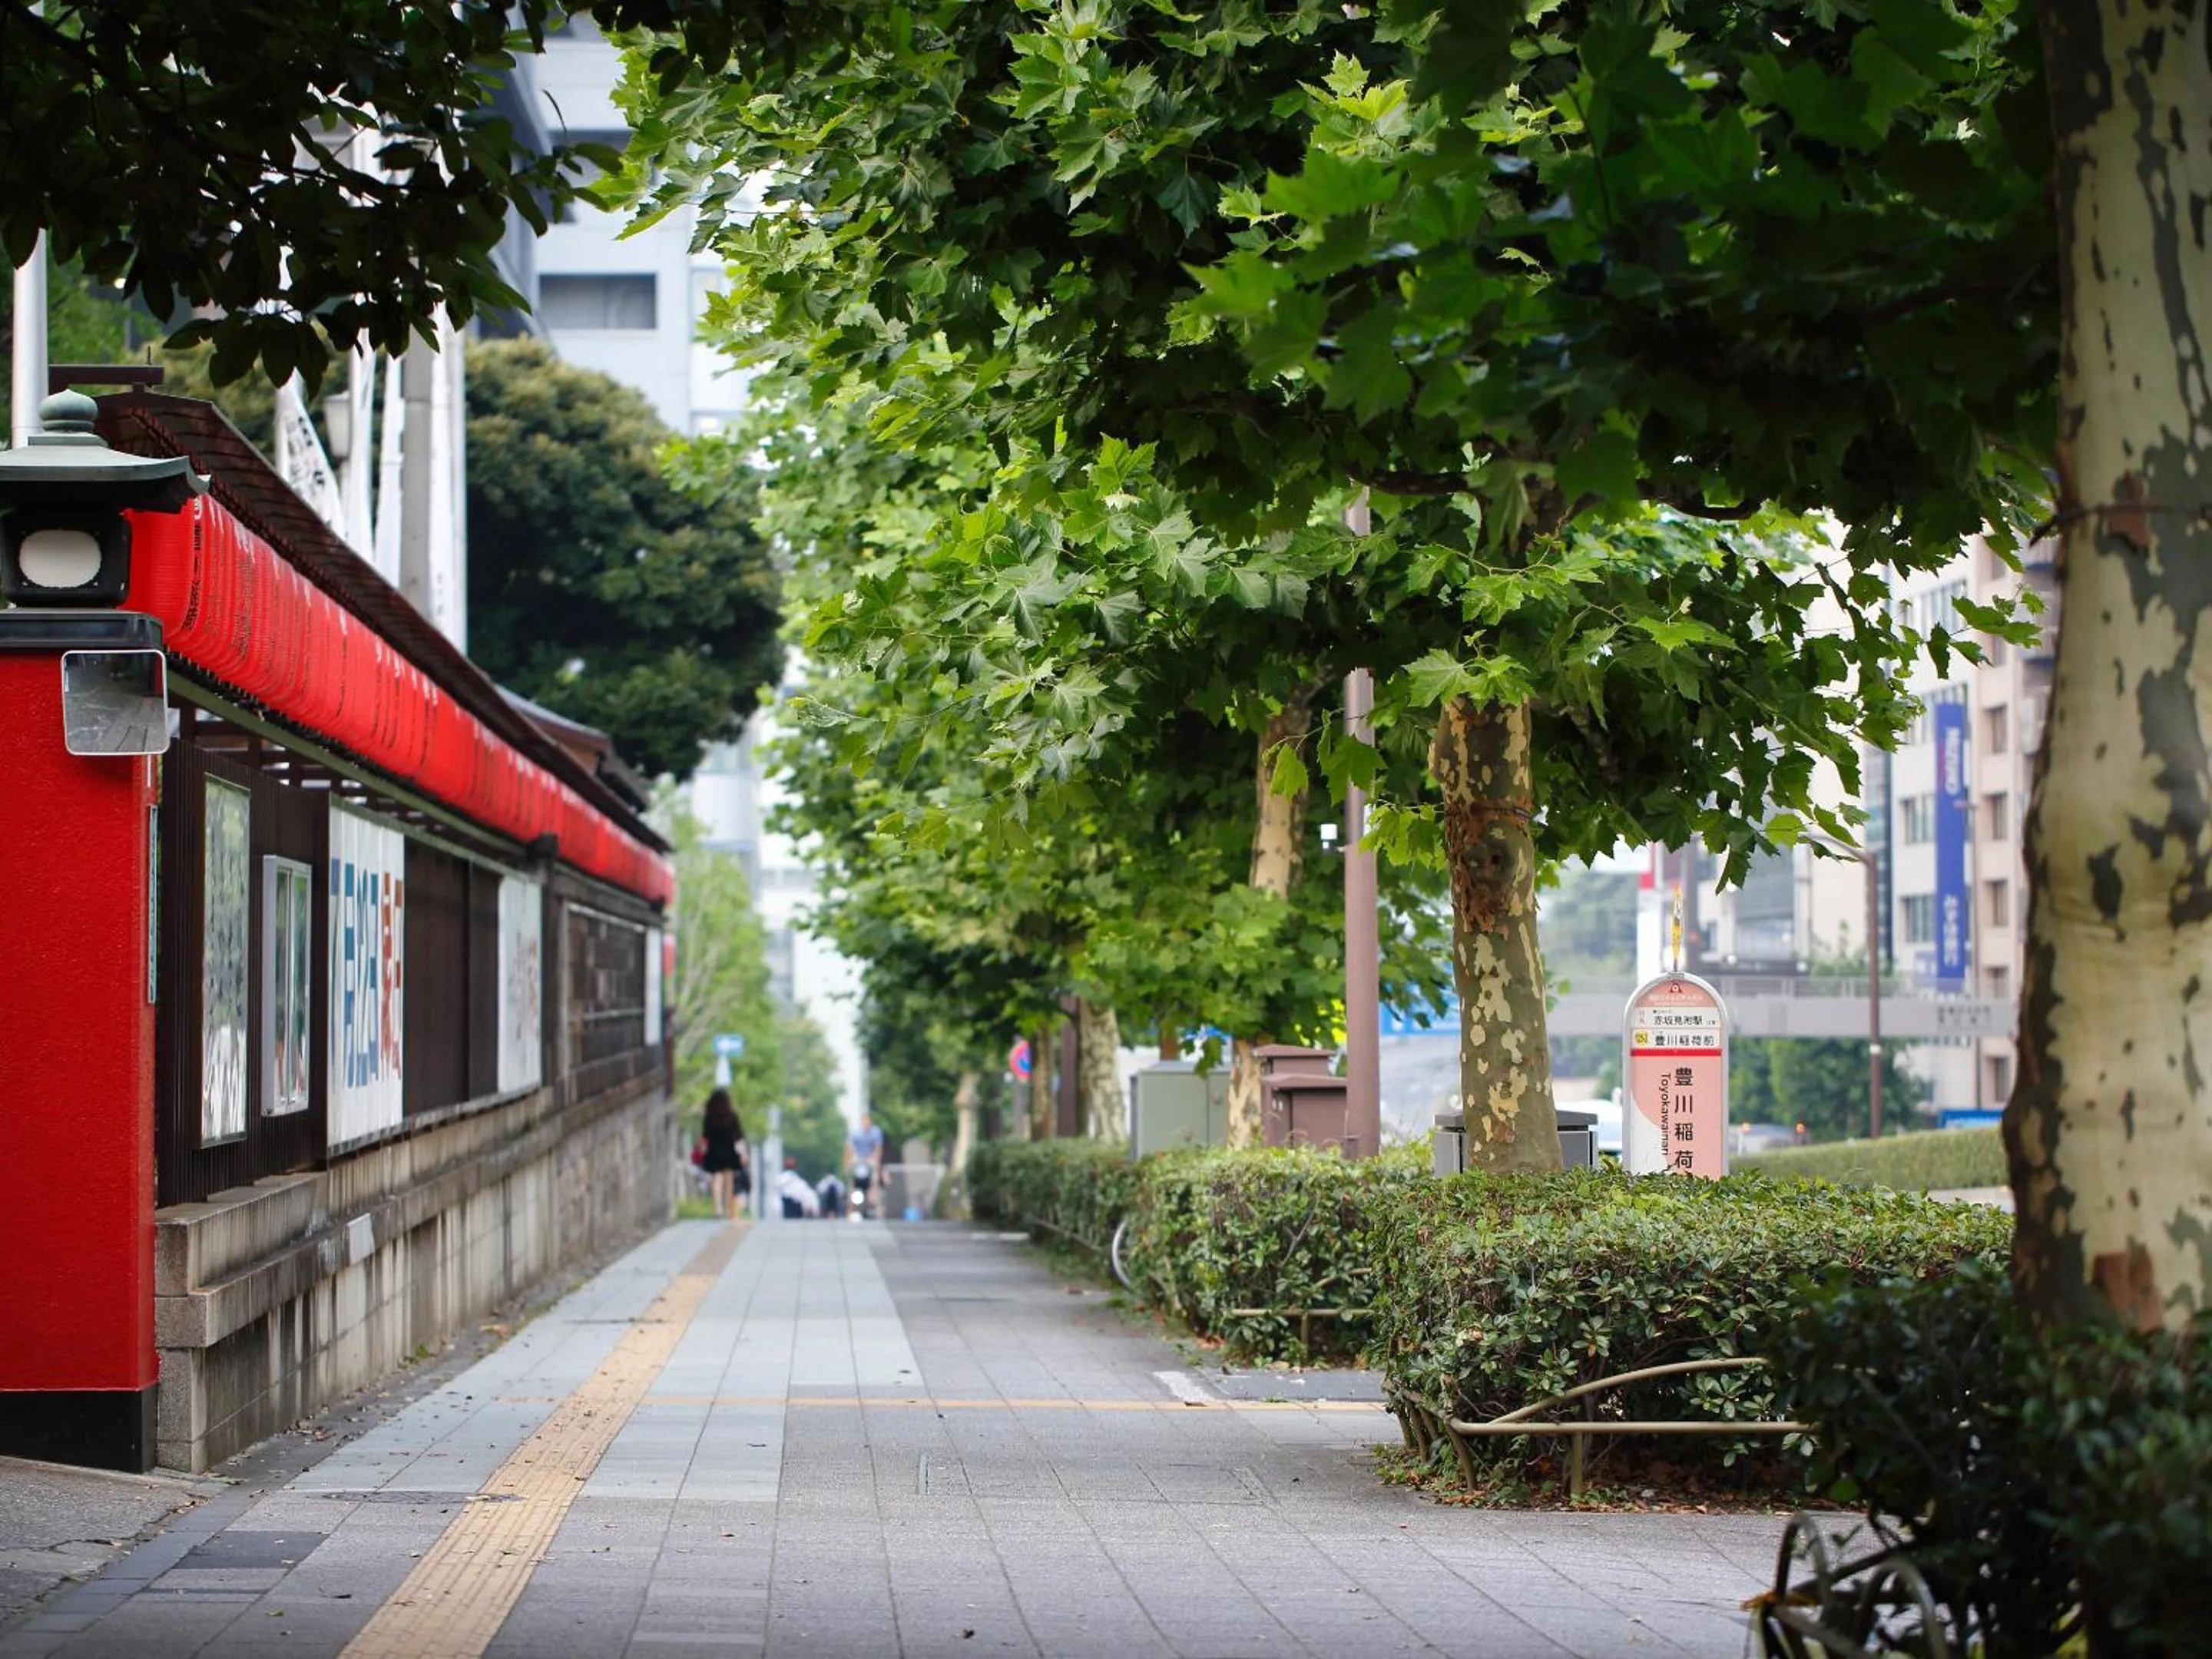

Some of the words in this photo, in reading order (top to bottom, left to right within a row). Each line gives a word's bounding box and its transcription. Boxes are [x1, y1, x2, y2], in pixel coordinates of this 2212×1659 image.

[1655, 1035, 1714, 1045] 豊川稲荷前
[1658, 1072, 1671, 1156] Toyokawainari
[1674, 1067, 1694, 1169] 豊川稲荷
